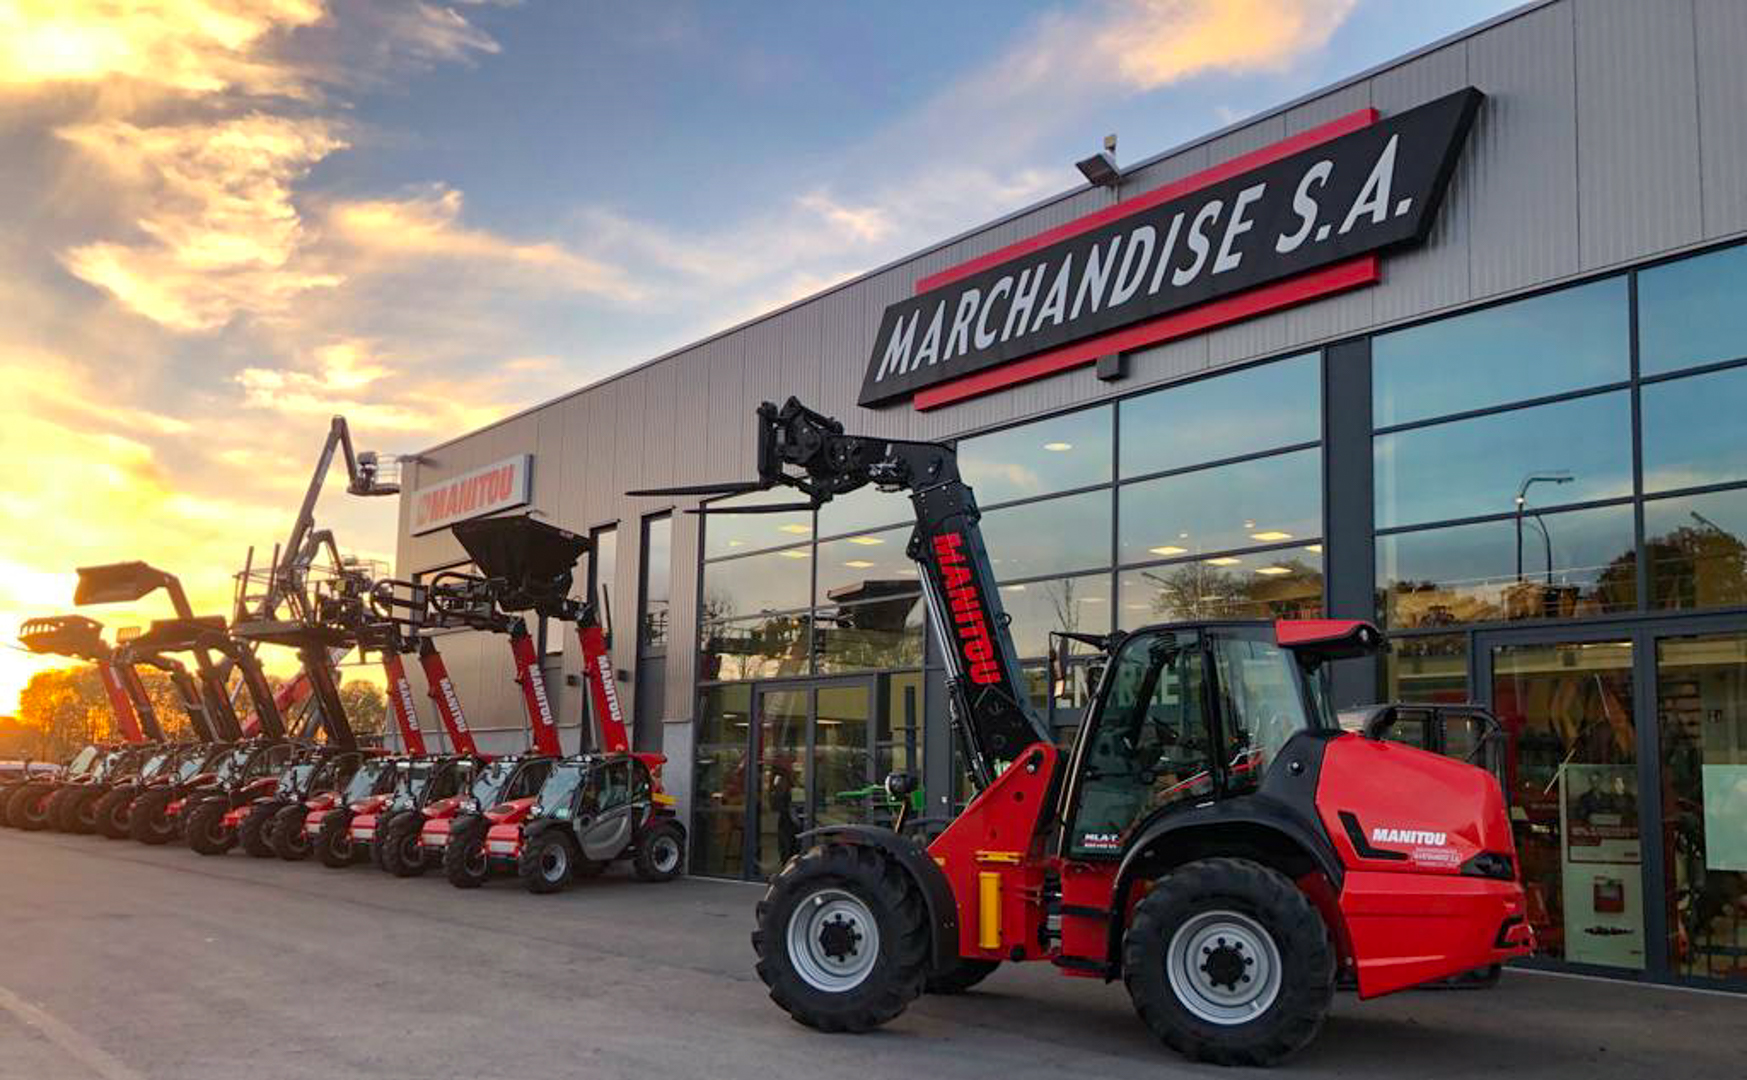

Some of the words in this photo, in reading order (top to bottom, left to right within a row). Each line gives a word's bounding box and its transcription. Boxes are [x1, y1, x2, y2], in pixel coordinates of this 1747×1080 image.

[875, 183, 1267, 382] MARCHANDISE
[1275, 133, 1414, 255] S.A.
[426, 464, 514, 521] MANITOU
[932, 531, 1002, 684] MANITOU
[397, 678, 419, 731] MANITOU
[440, 677, 467, 733] MANITOU
[529, 664, 554, 725] MANITOU
[597, 655, 622, 722] MANITOU
[1372, 828, 1447, 846] MANITOU
